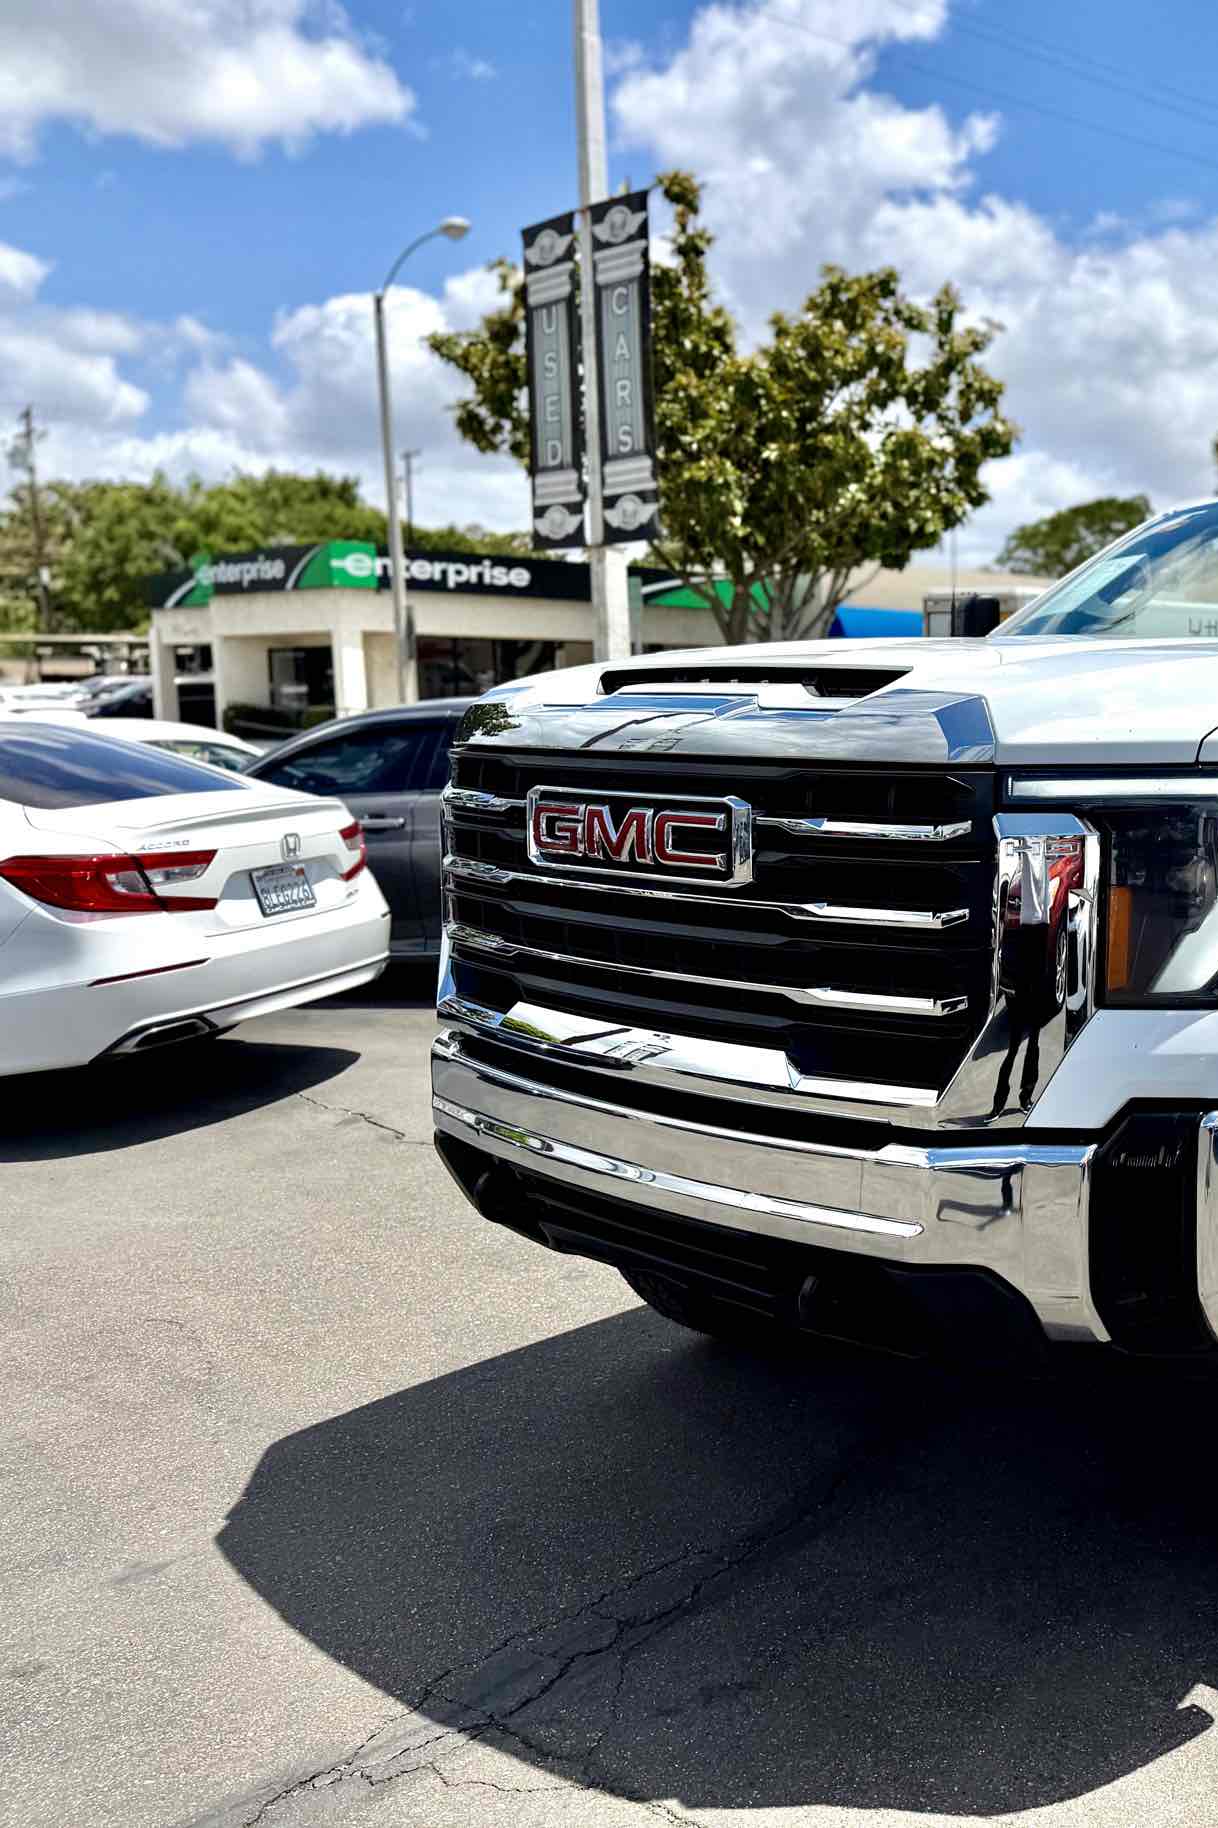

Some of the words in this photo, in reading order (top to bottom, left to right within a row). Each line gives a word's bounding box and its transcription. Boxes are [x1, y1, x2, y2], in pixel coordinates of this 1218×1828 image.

[541, 307, 563, 467] USED
[611, 285, 633, 454] CARS
[532, 802, 728, 871] GMC
